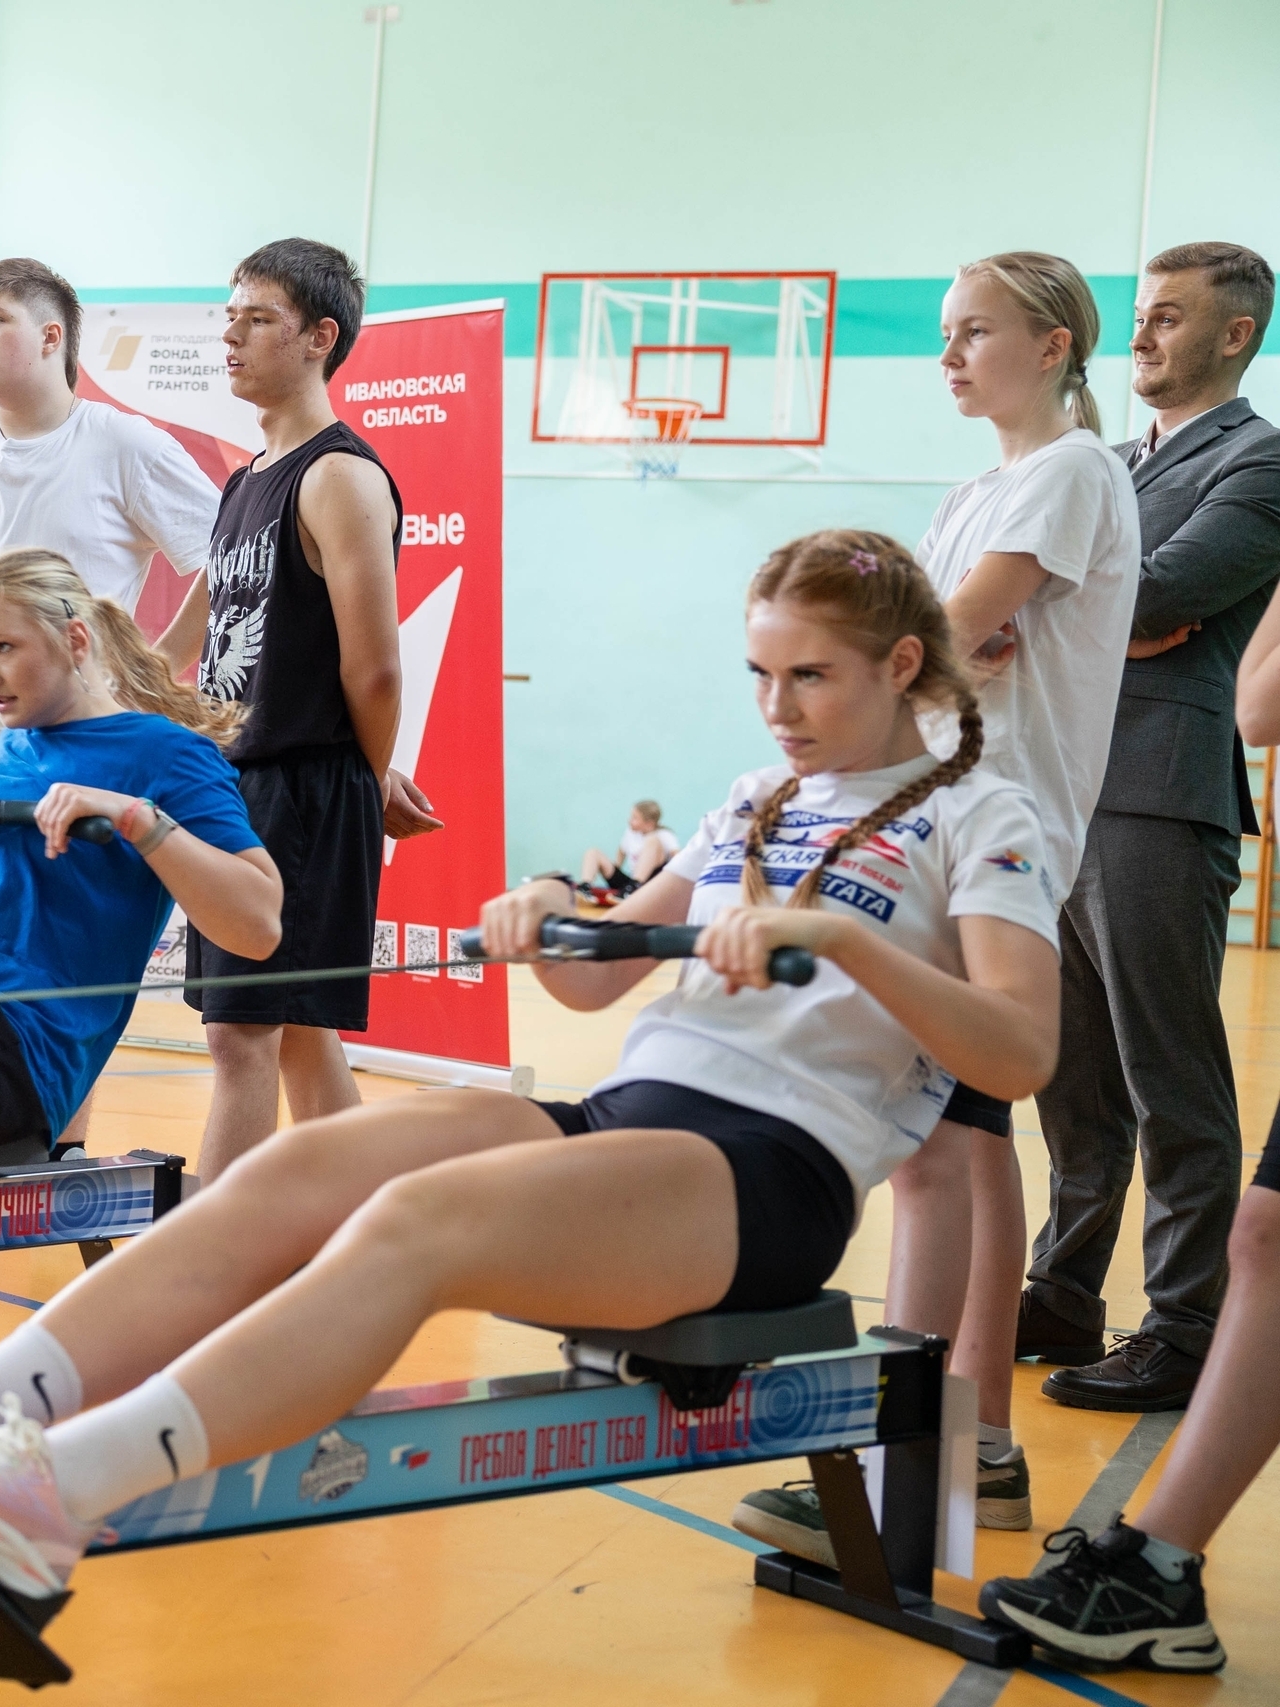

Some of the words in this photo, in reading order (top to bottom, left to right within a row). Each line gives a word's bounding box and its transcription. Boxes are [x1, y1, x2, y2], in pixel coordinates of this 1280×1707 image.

[150, 349, 200, 360] ФОНДА
[149, 365, 227, 376] ПРЕЗИДЕНТ
[148, 380, 209, 391] ГРАНТОВ
[345, 373, 466, 402] ИВАНОВСКАЯ
[362, 404, 447, 429] ОБЛАСТЬ
[459, 1430, 527, 1484] ГРЕБЛЯ
[532, 1420, 597, 1479] ДЕЛАЕТ
[605, 1415, 646, 1463] ТЕБЯ
[655, 1379, 751, 1458] ЛУЧШЕ!
